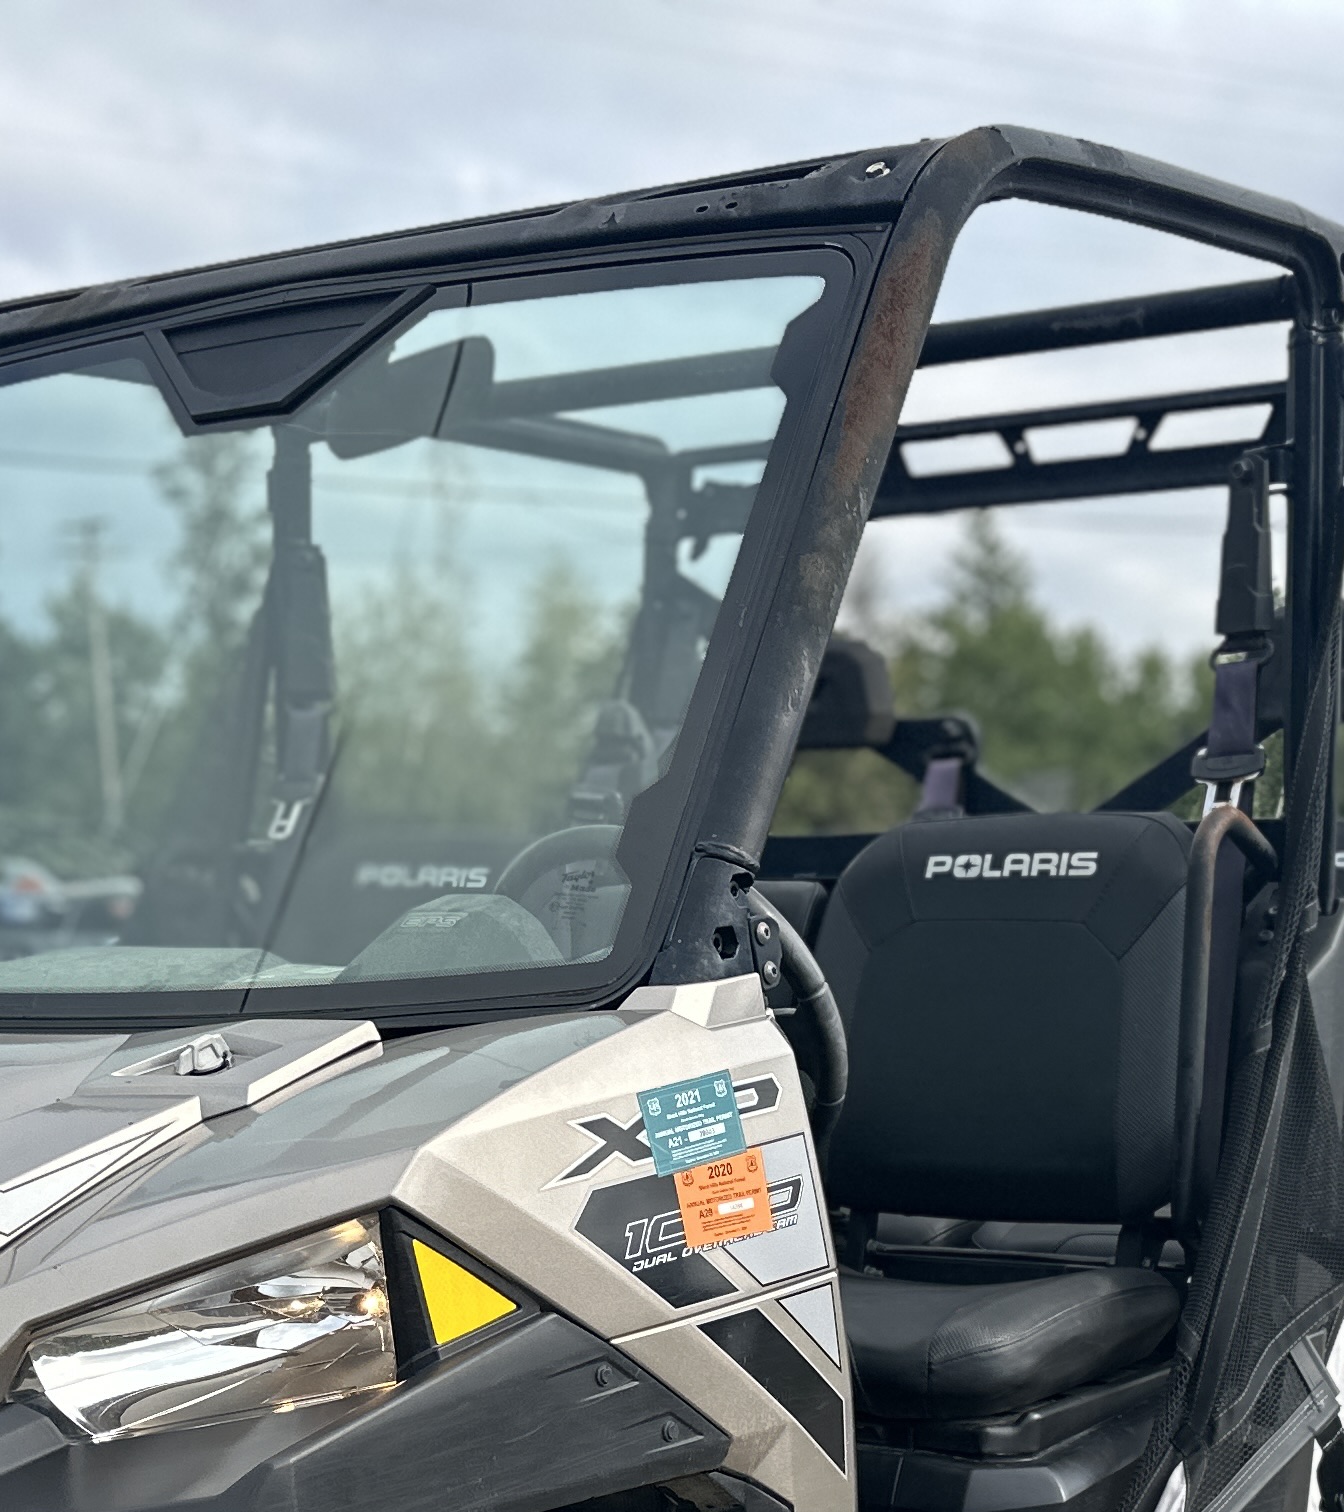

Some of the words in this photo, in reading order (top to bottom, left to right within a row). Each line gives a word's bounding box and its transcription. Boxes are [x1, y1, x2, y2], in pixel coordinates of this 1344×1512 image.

[356, 865, 490, 889] POLARIS
[924, 852, 1099, 880] POLARIS
[674, 1087, 702, 1109] 2021
[707, 1162, 733, 1180] 2020
[632, 1252, 678, 1272] DUAL
